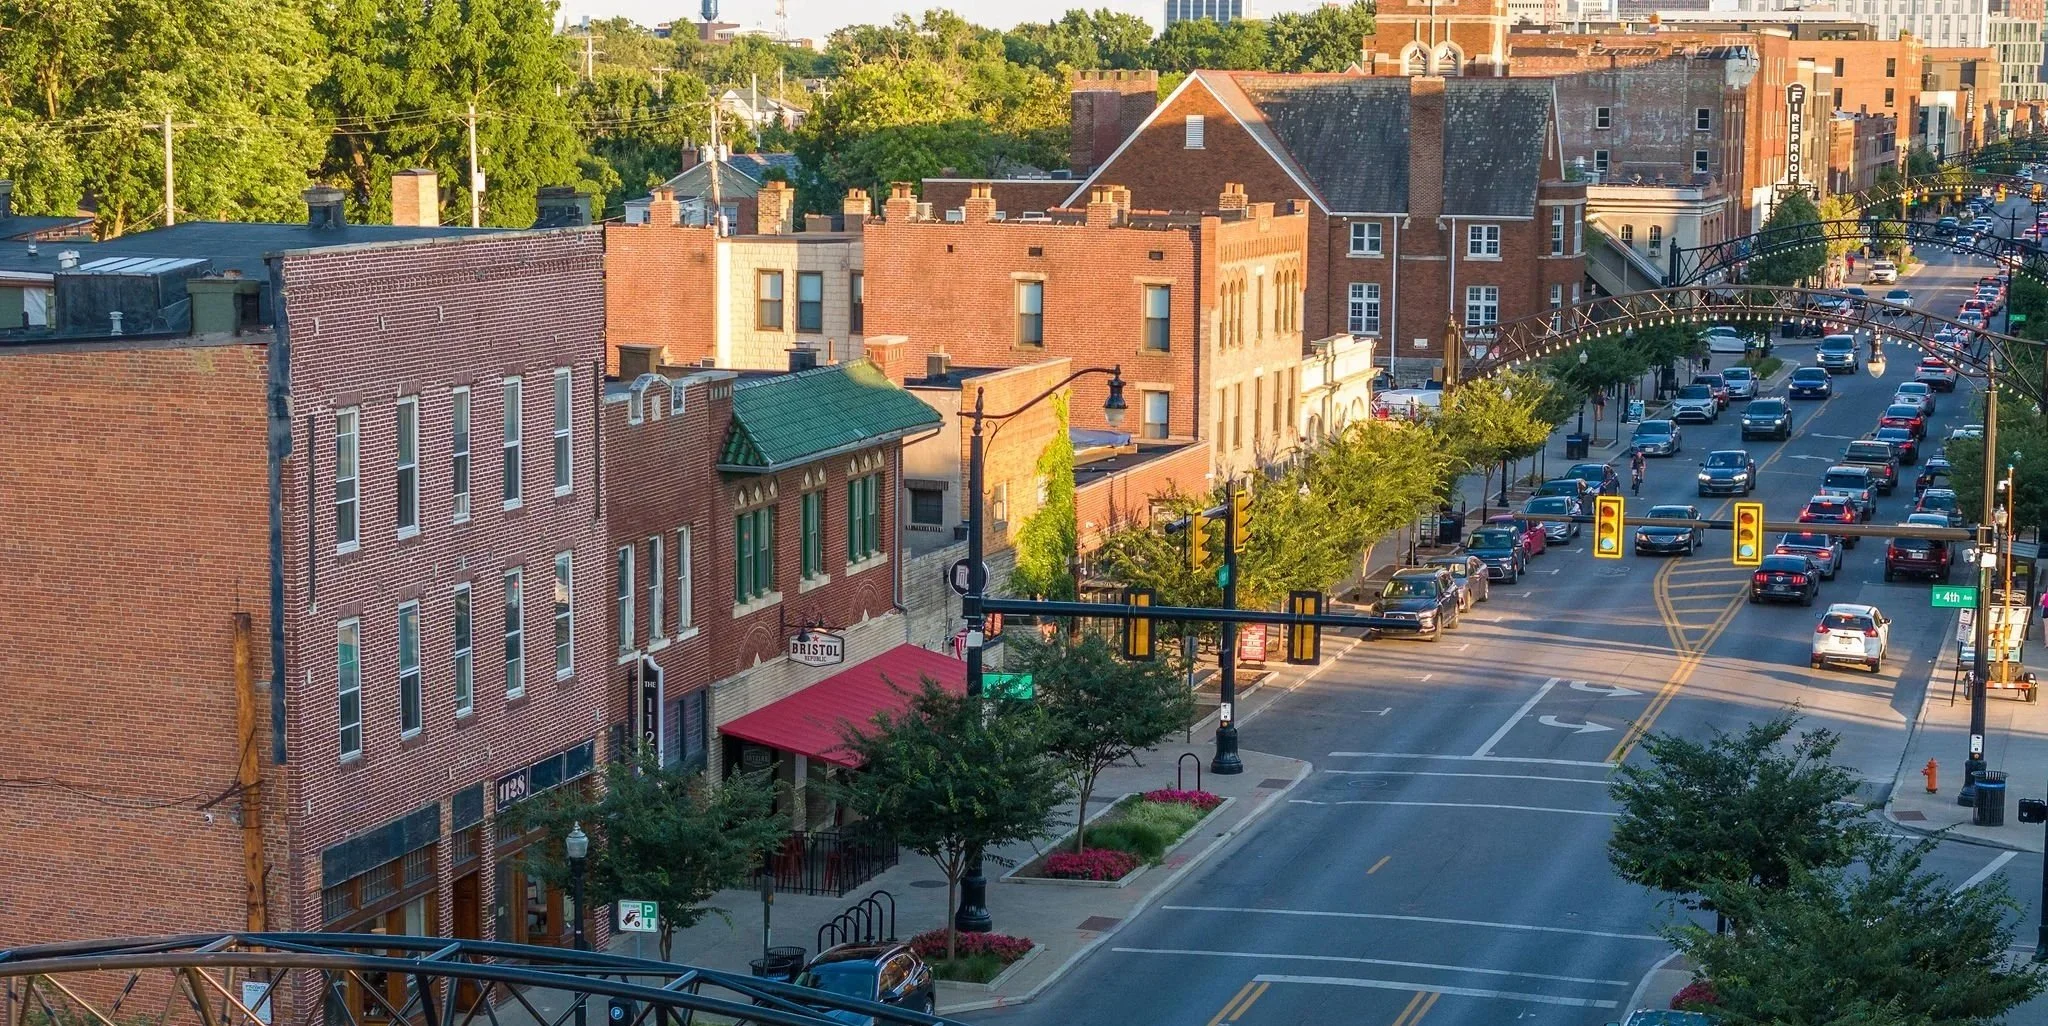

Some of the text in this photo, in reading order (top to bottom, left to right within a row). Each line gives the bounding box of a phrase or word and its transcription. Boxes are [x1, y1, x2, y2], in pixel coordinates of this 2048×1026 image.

[1789, 91, 1802, 182] FIREPROOF
[1943, 591, 1960, 603] 4th
[792, 642, 840, 657] BRISTOL
[645, 697, 656, 760] 112
[499, 774, 526, 801] 1128
[644, 904, 654, 917] P
[614, 1009, 621, 1018] P
